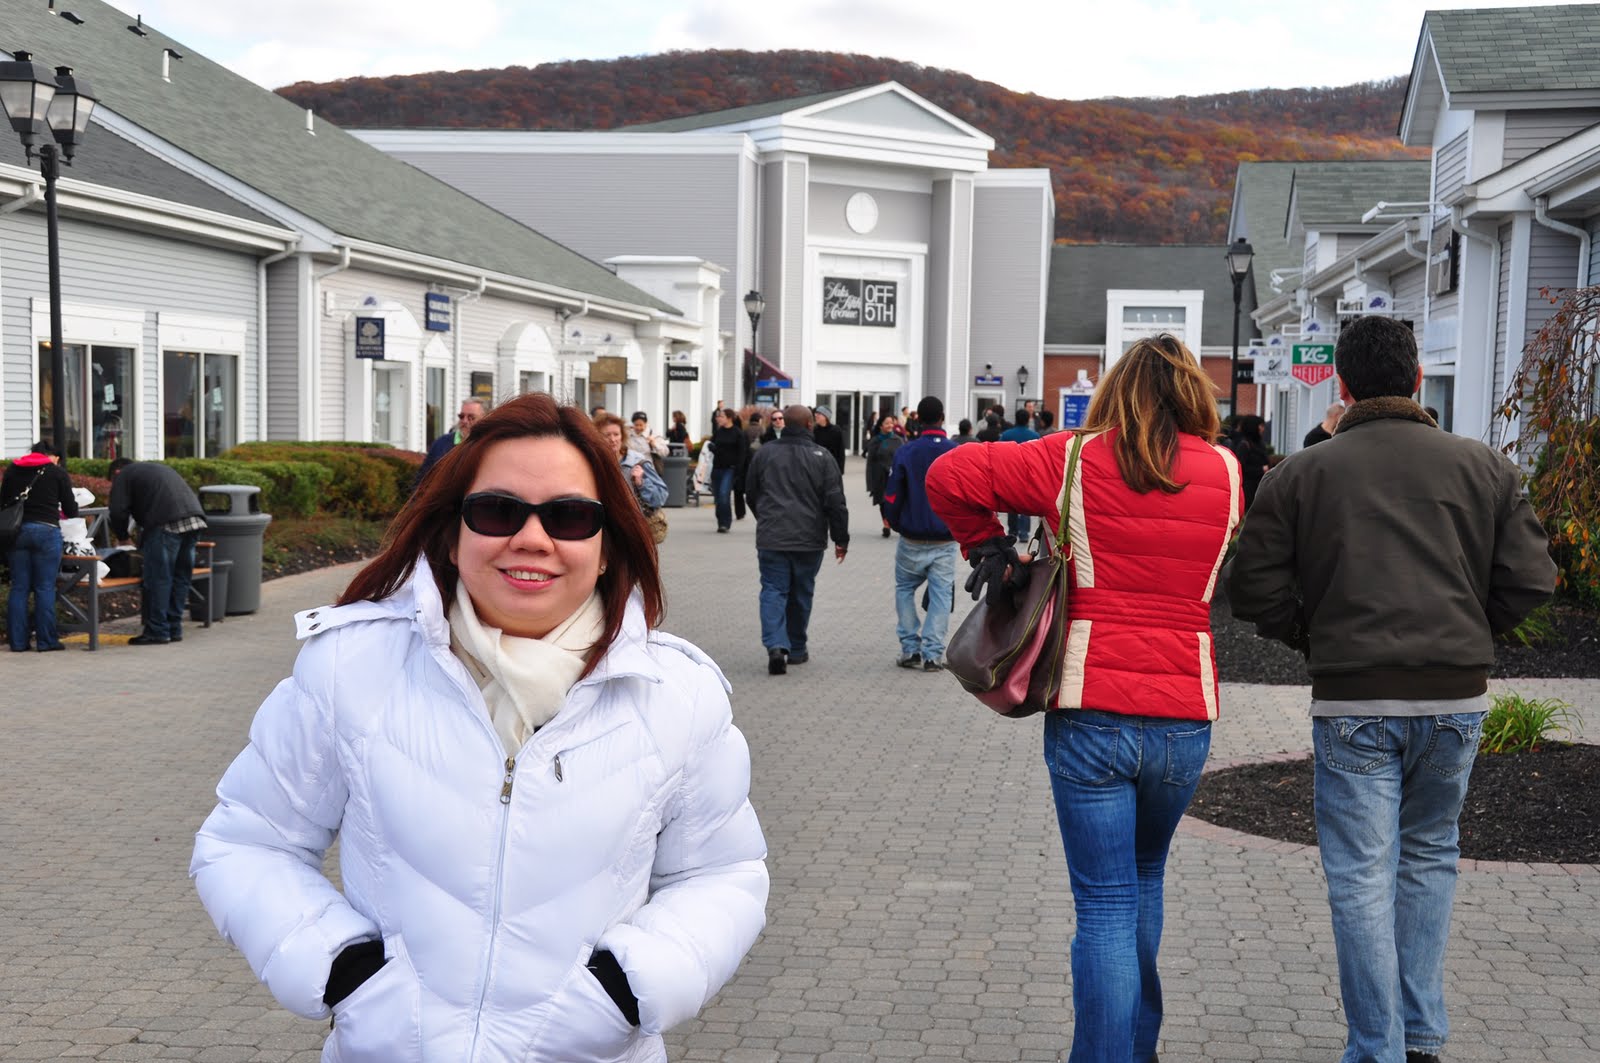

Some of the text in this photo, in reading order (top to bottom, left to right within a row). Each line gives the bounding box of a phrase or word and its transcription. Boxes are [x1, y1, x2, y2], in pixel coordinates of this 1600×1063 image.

[865, 284, 894, 303] OFF
[865, 302, 894, 322] 5TH
[1298, 346, 1328, 364] TAG
[669, 370, 697, 378] CHANEL
[1293, 366, 1332, 384] HEUER
